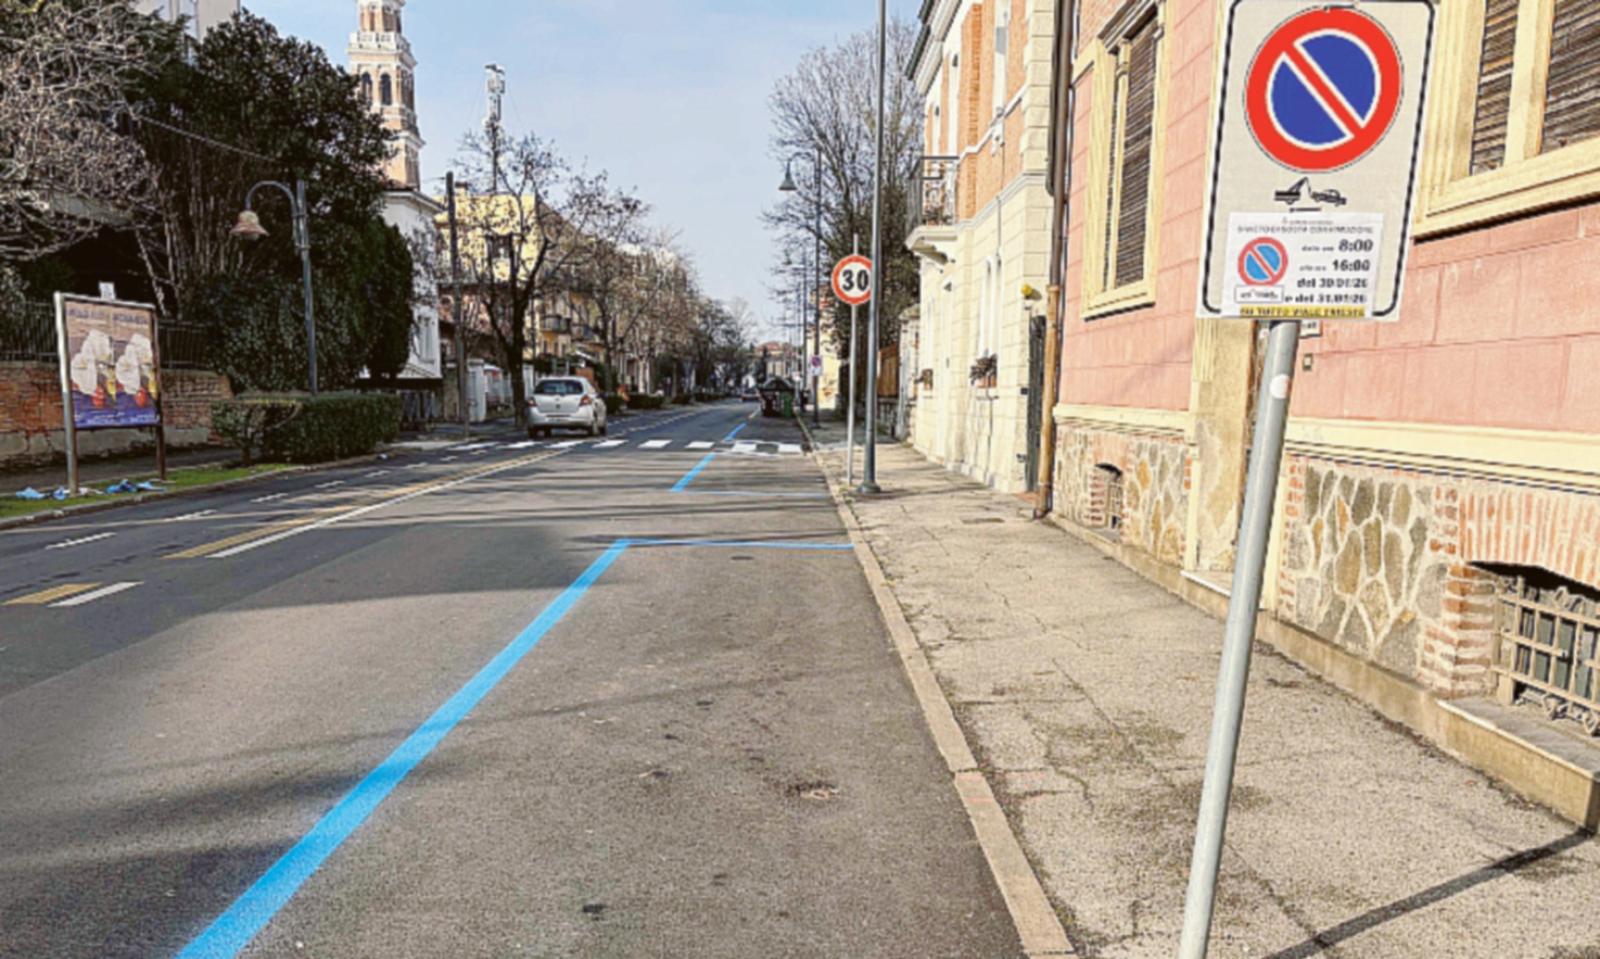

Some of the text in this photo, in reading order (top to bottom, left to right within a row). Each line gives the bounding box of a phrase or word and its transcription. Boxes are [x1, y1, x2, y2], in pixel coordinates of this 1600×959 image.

[1338, 239, 1374, 252] 8:00
[1332, 259, 1371, 271] 16:00
[842, 269, 869, 292] 30
